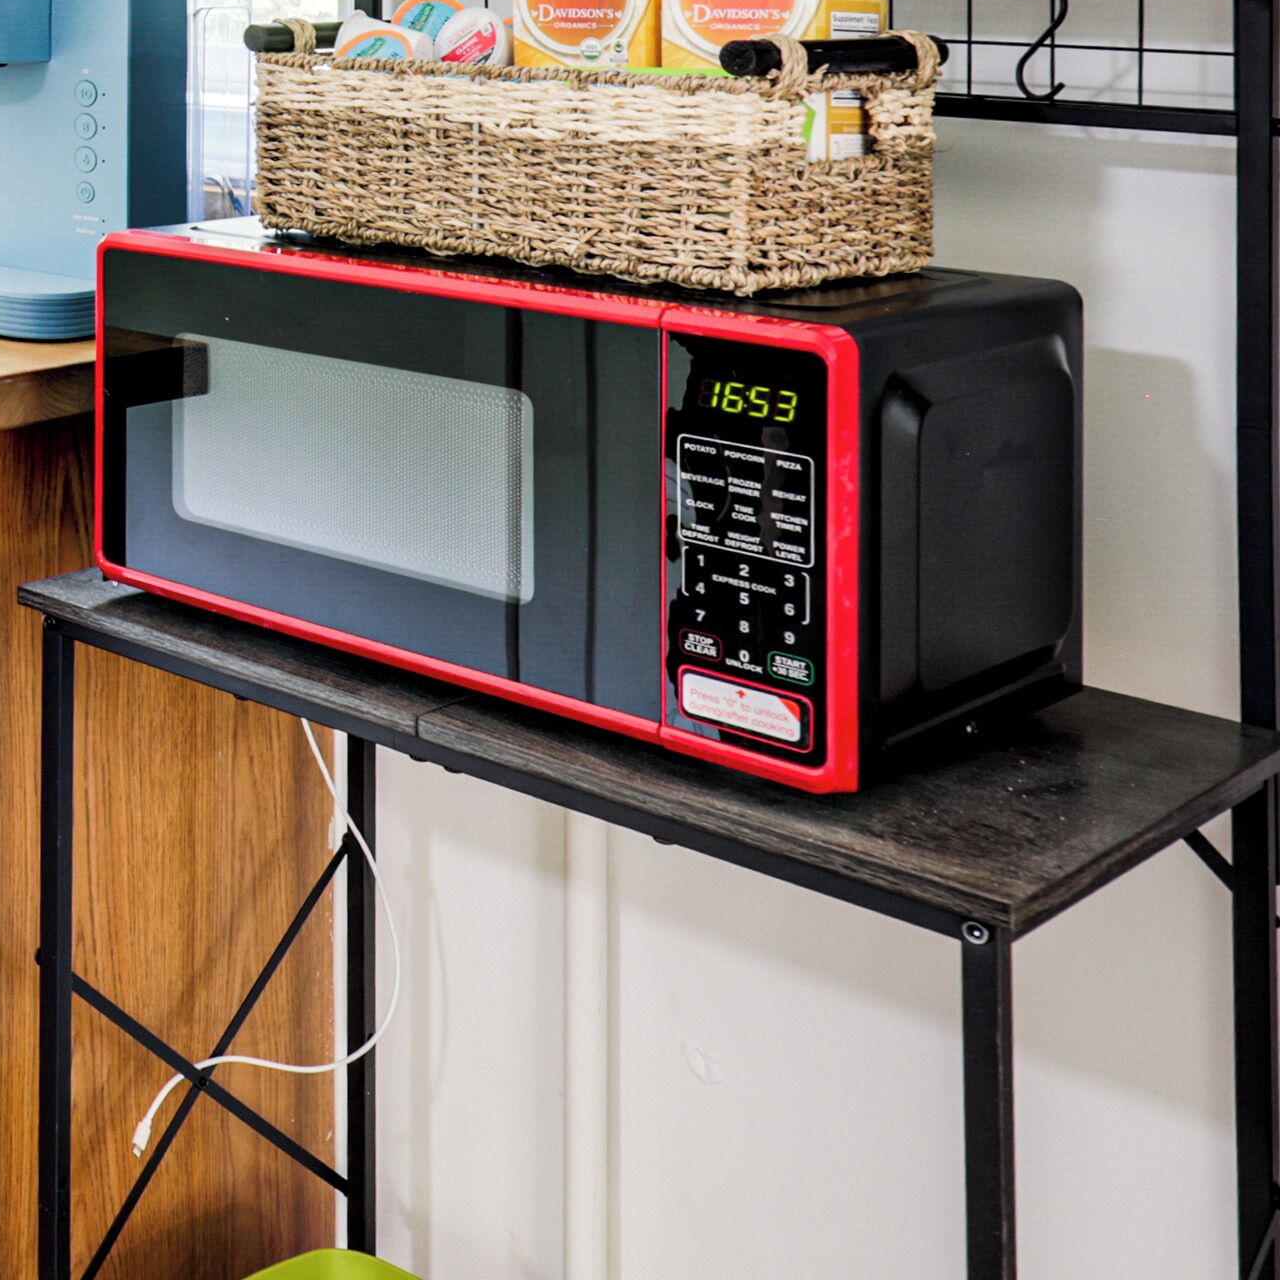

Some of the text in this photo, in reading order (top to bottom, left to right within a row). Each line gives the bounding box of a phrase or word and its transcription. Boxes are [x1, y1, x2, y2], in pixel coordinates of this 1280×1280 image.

[711, 382, 797, 422] 16:53
[684, 443, 717, 454] POTATO
[724, 450, 765, 463] POPCORN
[776, 460, 802, 471] PIZZA
[681, 472, 725, 486] BEVERAGE
[728, 477, 762, 489] FROZEN
[728, 485, 760, 497] DINNER
[772, 489, 806, 502] REHEAT
[686, 499, 715, 511] CLOCK
[734, 504, 754, 514] TIME
[731, 512, 756, 523] COOK
[770, 512, 808, 526] KITCHEN
[691, 523, 710, 533] TIME
[775, 521, 802, 533] TIMER
[682, 529, 719, 542] DEFROST
[727, 531, 760, 544] WEIGHT
[725, 539, 763, 552] DEFROST
[773, 541, 805, 554] POWER
[697, 554, 705, 566] 1
[775, 550, 803, 562] LEVEL
[739, 564, 749, 576] 2
[712, 574, 777, 595] EXPRESS COOK
[784, 574, 794, 587] 3
[695, 582, 705, 594] 4
[739, 593, 749, 605] 5
[695, 609, 706, 622] 7
[784, 603, 794, 616] 6
[739, 621, 749, 633] 8
[688, 633, 714, 646] STOP
[784, 632, 795, 644] 9
[684, 642, 717, 657] CLEAR
[739, 650, 749, 662] 0
[725, 658, 763, 674] UNLOCK
[774, 655, 806, 670] START
[690, 687, 720, 704] Press
[740, 702, 751, 712] to
[754, 708, 789, 722] unlock
[752, 719, 794, 737] cooking
